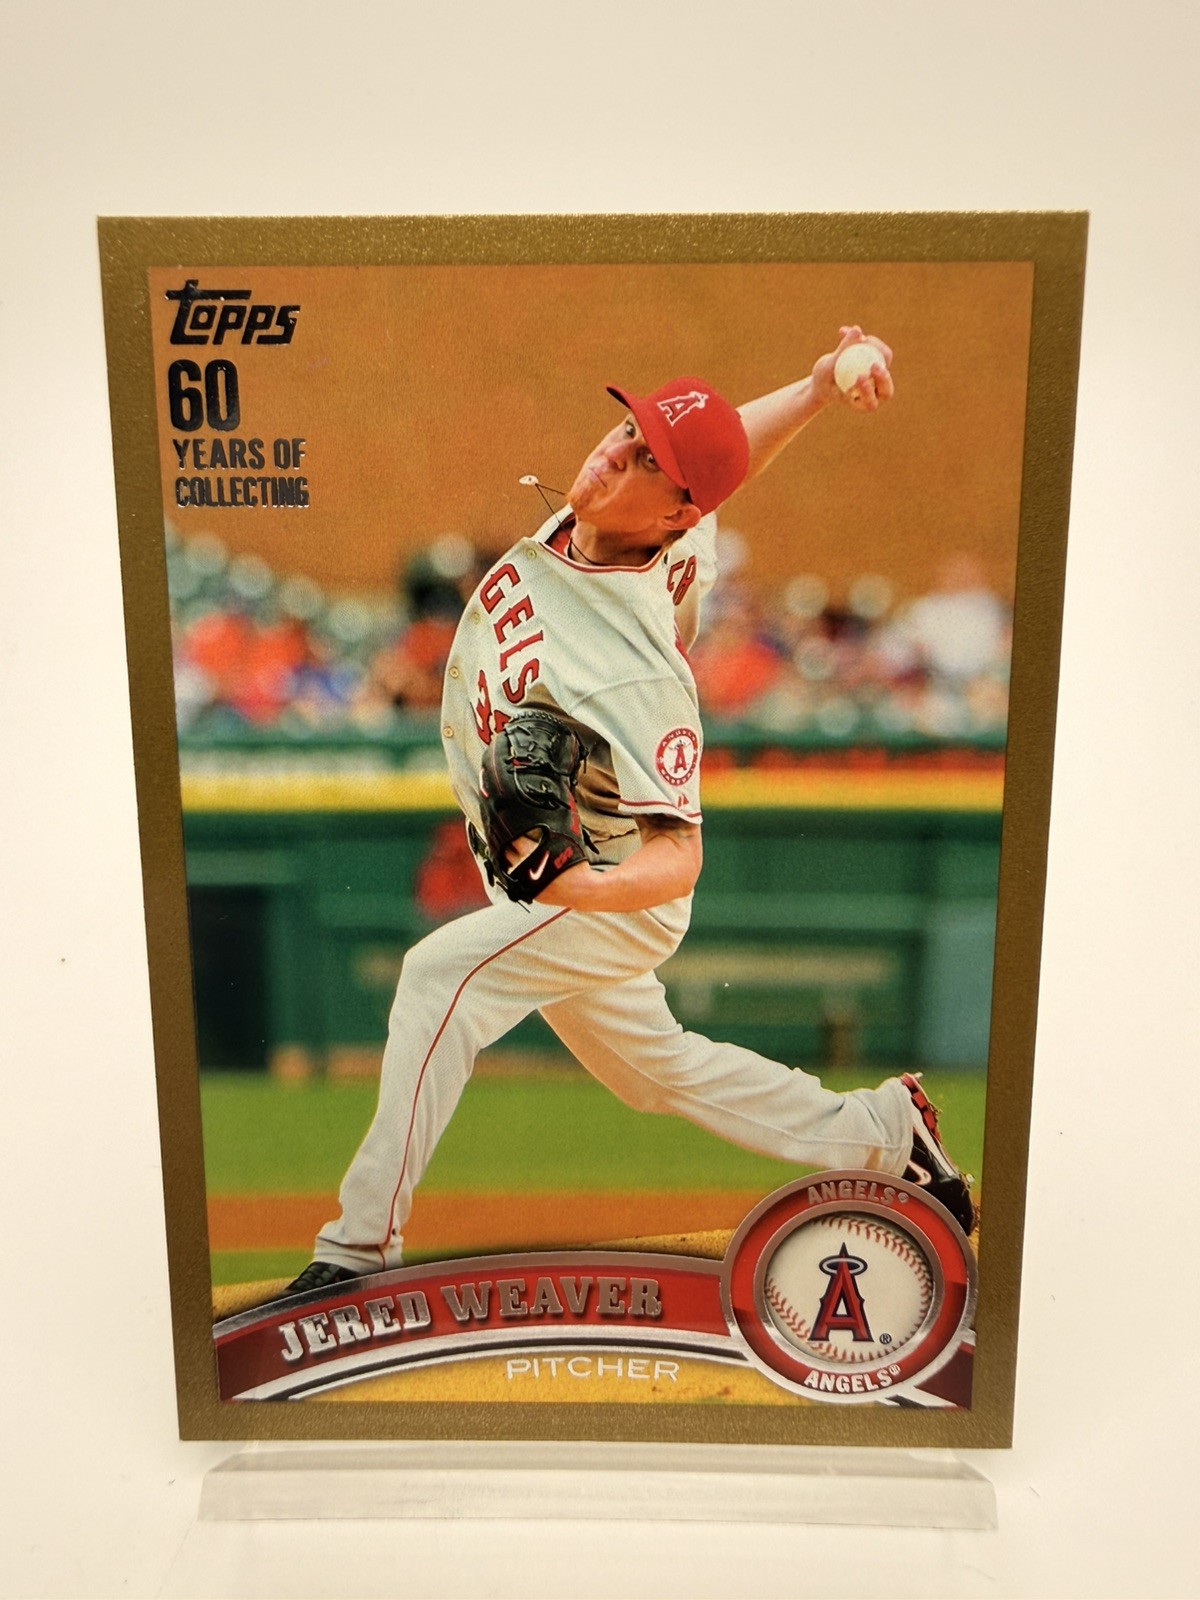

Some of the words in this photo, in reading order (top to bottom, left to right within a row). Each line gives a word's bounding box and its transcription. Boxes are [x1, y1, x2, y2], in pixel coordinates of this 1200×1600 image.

[166, 279, 301, 345] topps
[168, 359, 240, 432] 60
[173, 438, 266, 471] YEARS
[273, 438, 307, 470] OF
[175, 476, 309, 508] COLLECTING
[278, 1290, 431, 1362] JERED
[440, 1276, 663, 1323] WEAVER
[808, 1242, 874, 1342] A
[506, 1356, 680, 1382] PITCHER
